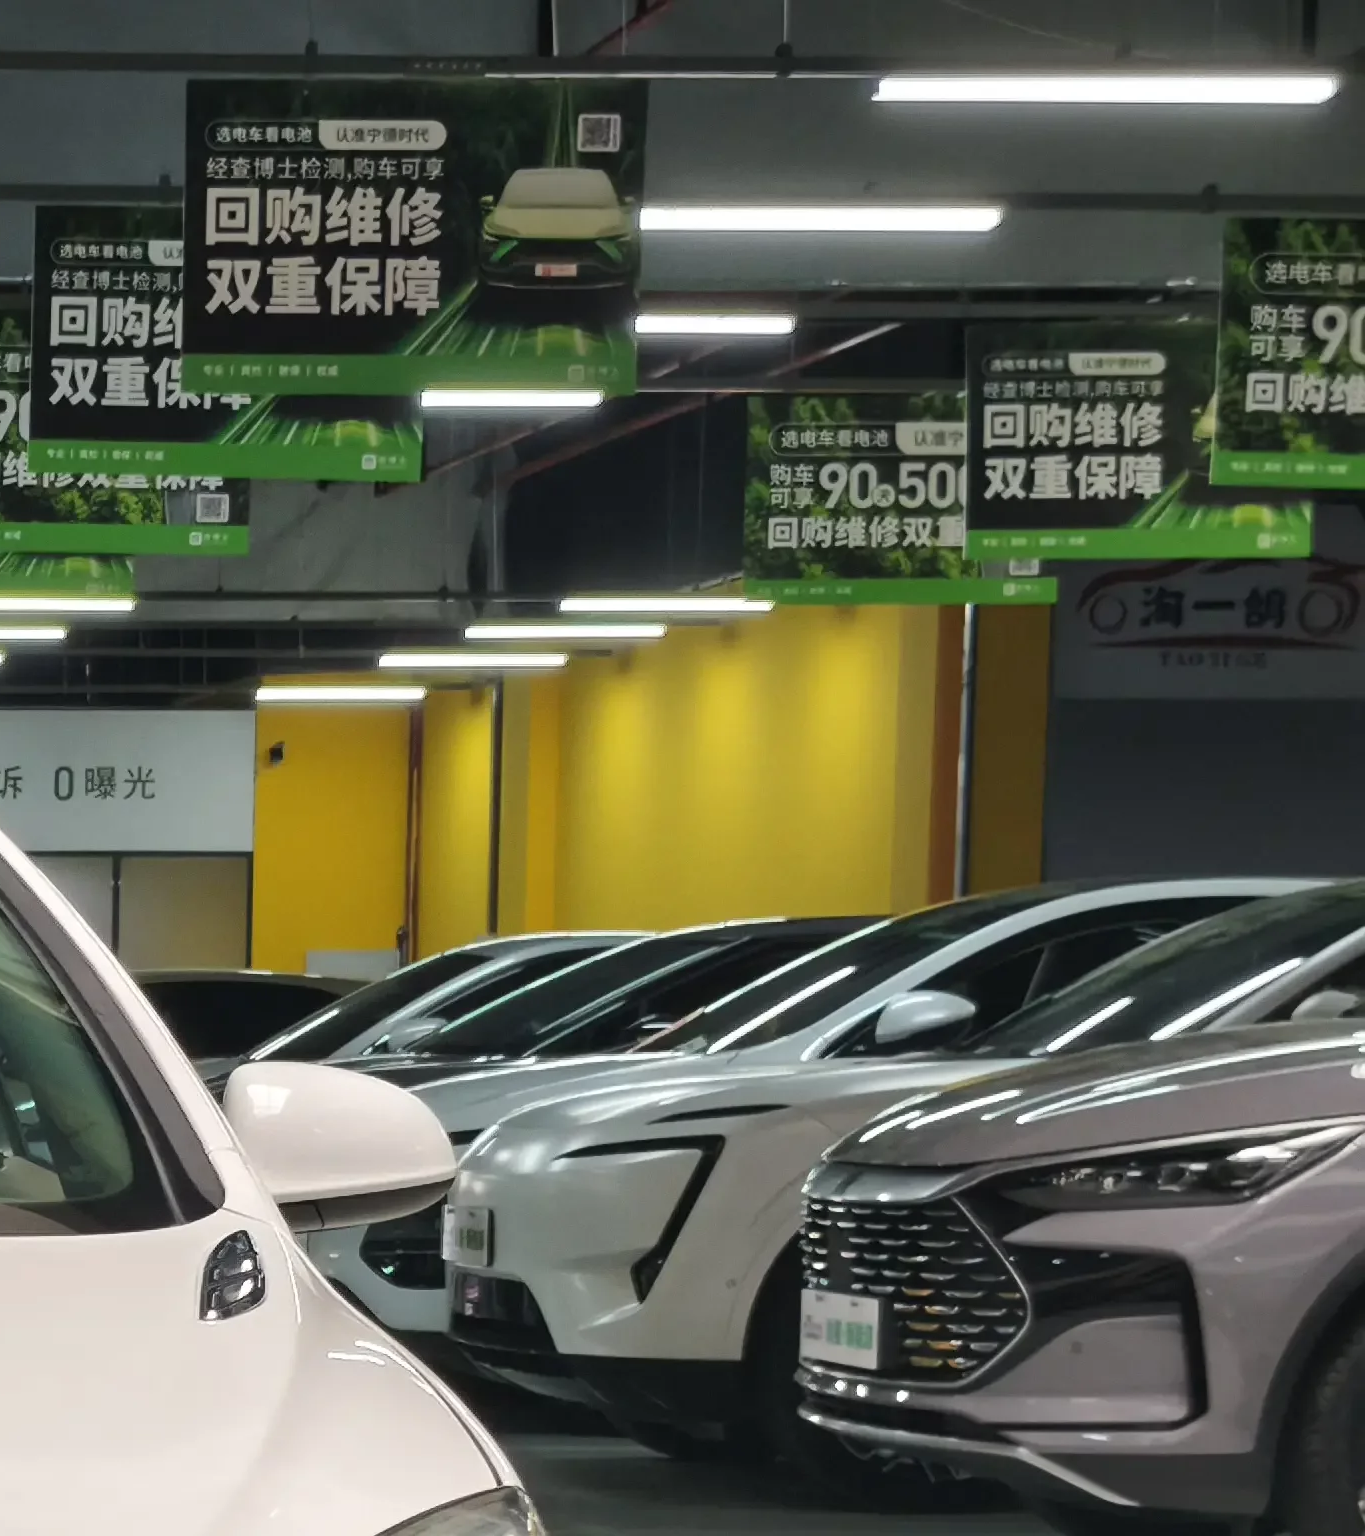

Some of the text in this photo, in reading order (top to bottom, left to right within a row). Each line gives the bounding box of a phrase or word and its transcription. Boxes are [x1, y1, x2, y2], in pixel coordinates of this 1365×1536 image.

[216, 126, 430, 144] 选电车看电池 认准宁德时代
[207, 157, 445, 181] 经查博士检测,购车可享
[204, 187, 442, 246] 回购维修
[60, 244, 144, 259] 选电车看电池
[204, 256, 441, 317] 双重保障
[1250, 304, 1306, 332] 购车
[1249, 335, 1306, 362] 可享
[1245, 372, 1365, 415] 回购维
[781, 429, 889, 449] 选电车看电池
[983, 402, 1163, 449] 回购维修
[770, 464, 814, 486] 购车
[984, 453, 1162, 500] 双重保障
[770, 488, 814, 509] 可享
[53, 765, 156, 802] 0曝光
